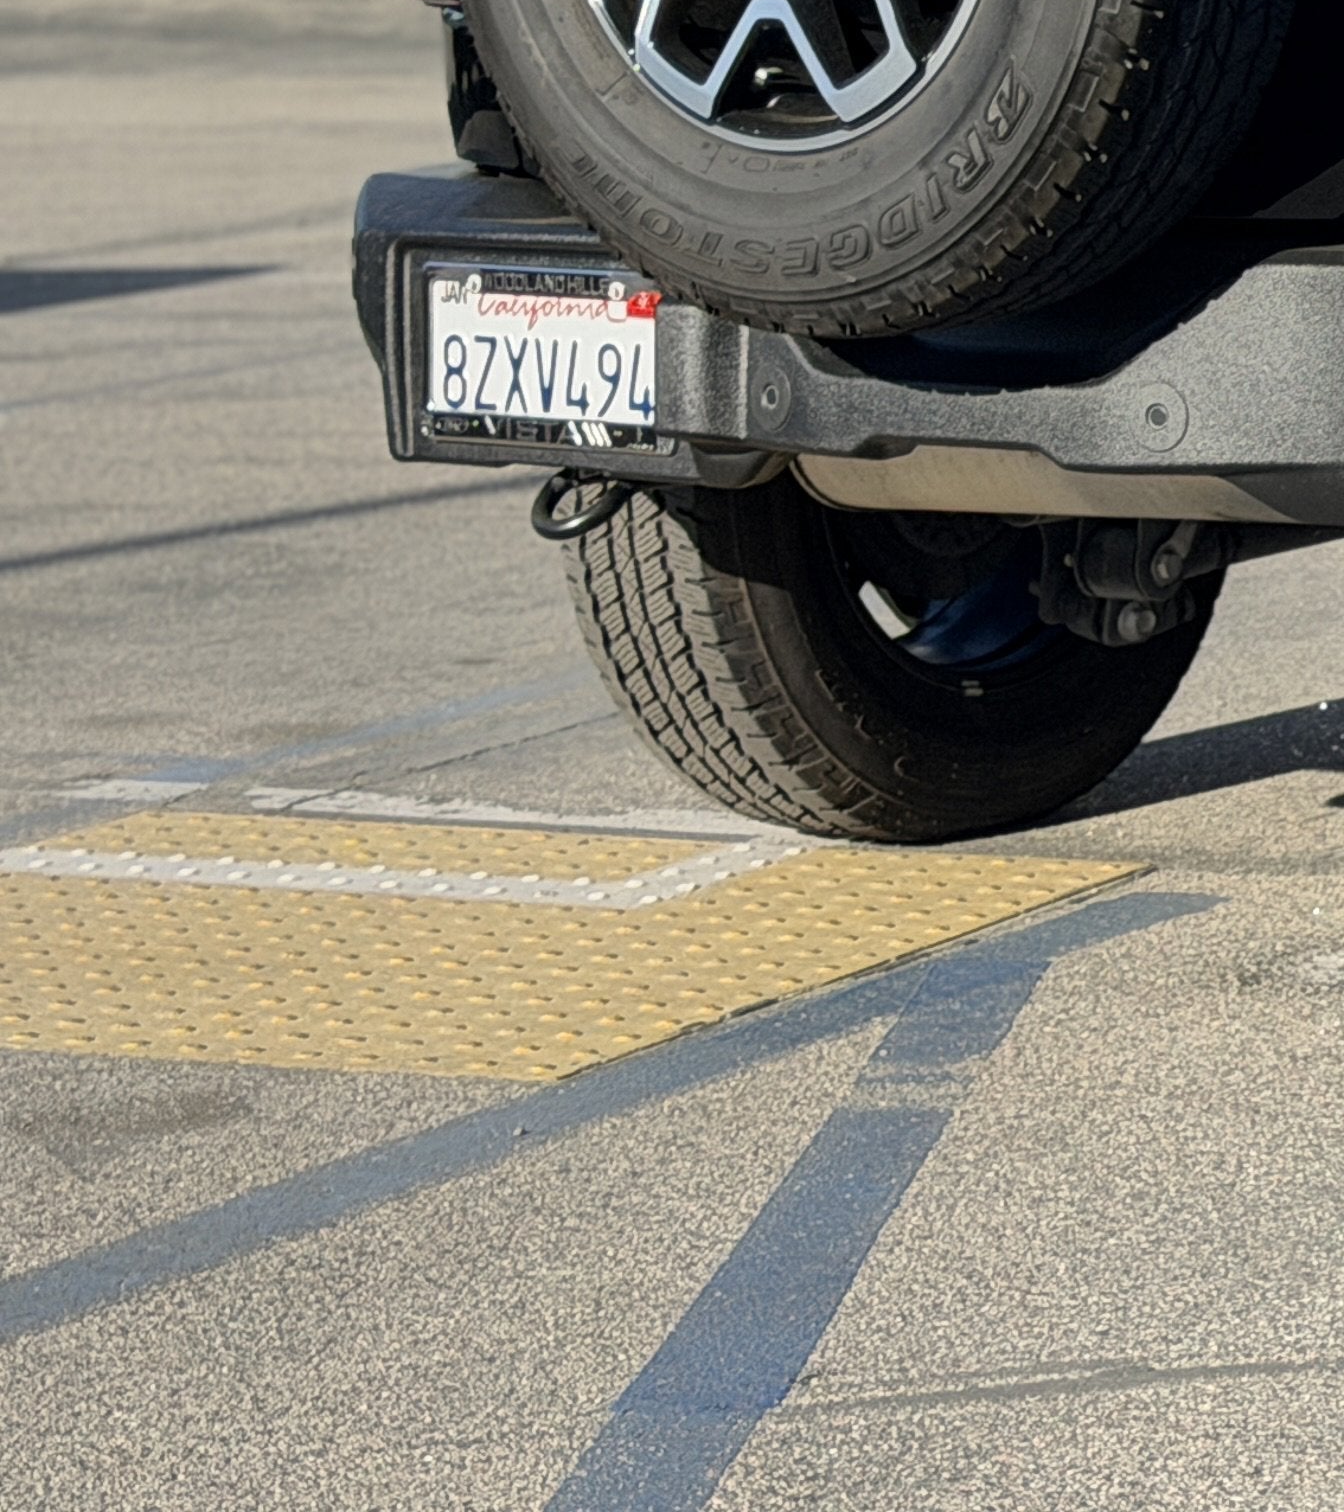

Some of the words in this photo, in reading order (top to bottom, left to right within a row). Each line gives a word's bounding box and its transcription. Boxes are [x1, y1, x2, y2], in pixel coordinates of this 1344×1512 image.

[566, 54, 1034, 278] BRIDGESTONE
[478, 292, 609, 331] California
[443, 334, 655, 422] 8ZXV494
